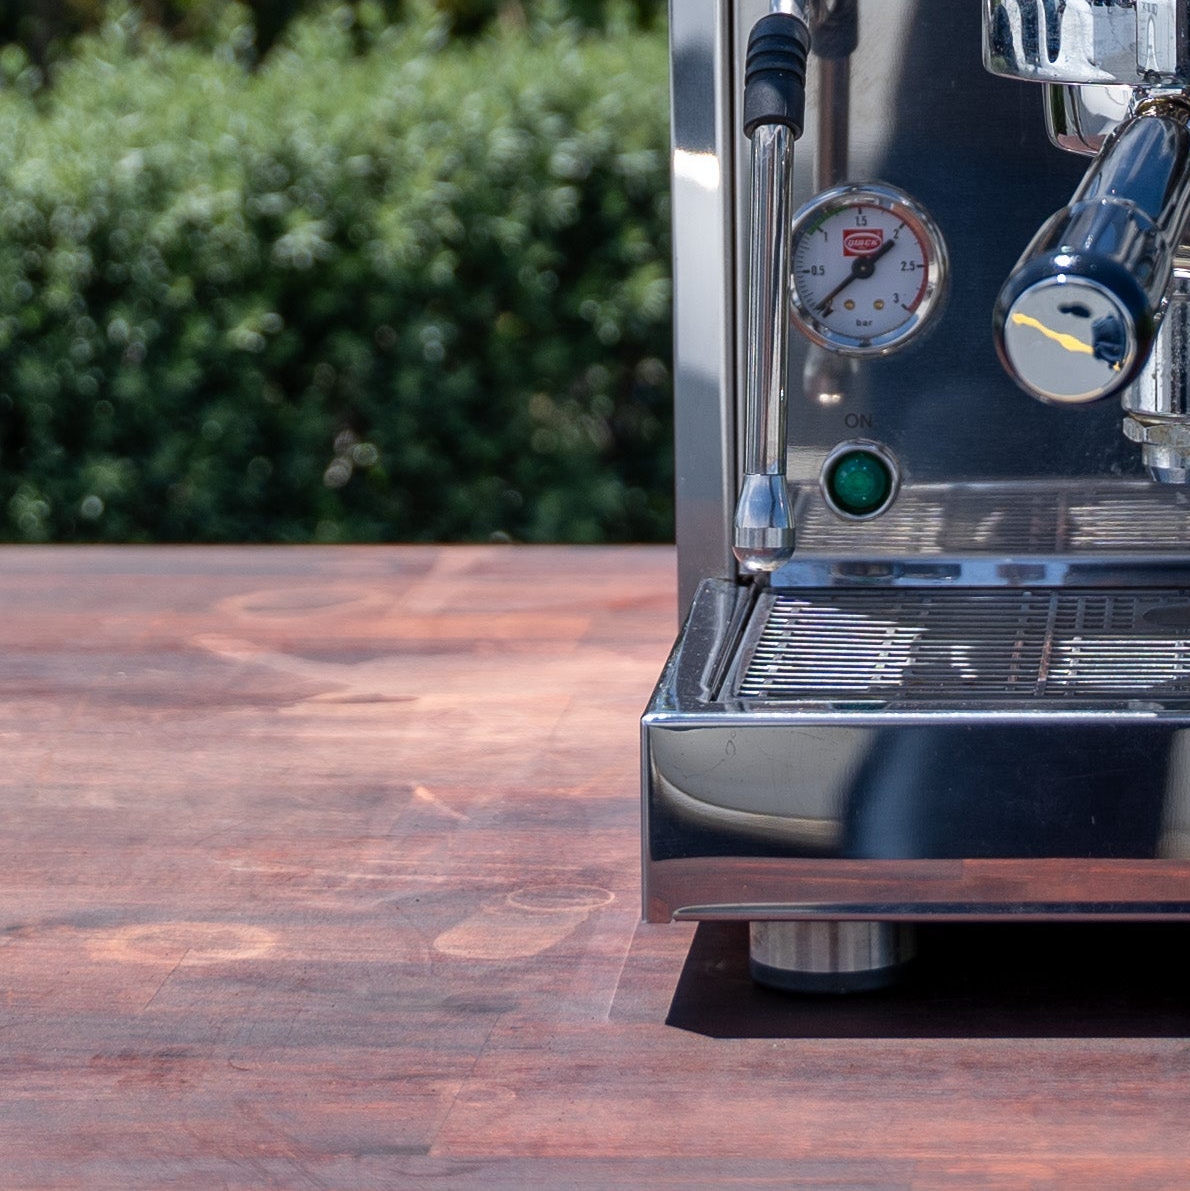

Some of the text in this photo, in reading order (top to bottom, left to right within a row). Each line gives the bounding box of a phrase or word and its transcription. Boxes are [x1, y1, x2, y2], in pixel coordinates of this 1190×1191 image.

[823, 232, 828, 242] 1
[893, 229, 899, 239] 2
[811, 265, 825, 276] 0.5
[901, 261, 915, 272] 2.5
[893, 293, 899, 303] 3
[856, 318, 873, 327] bar
[844, 413, 873, 428] ON
